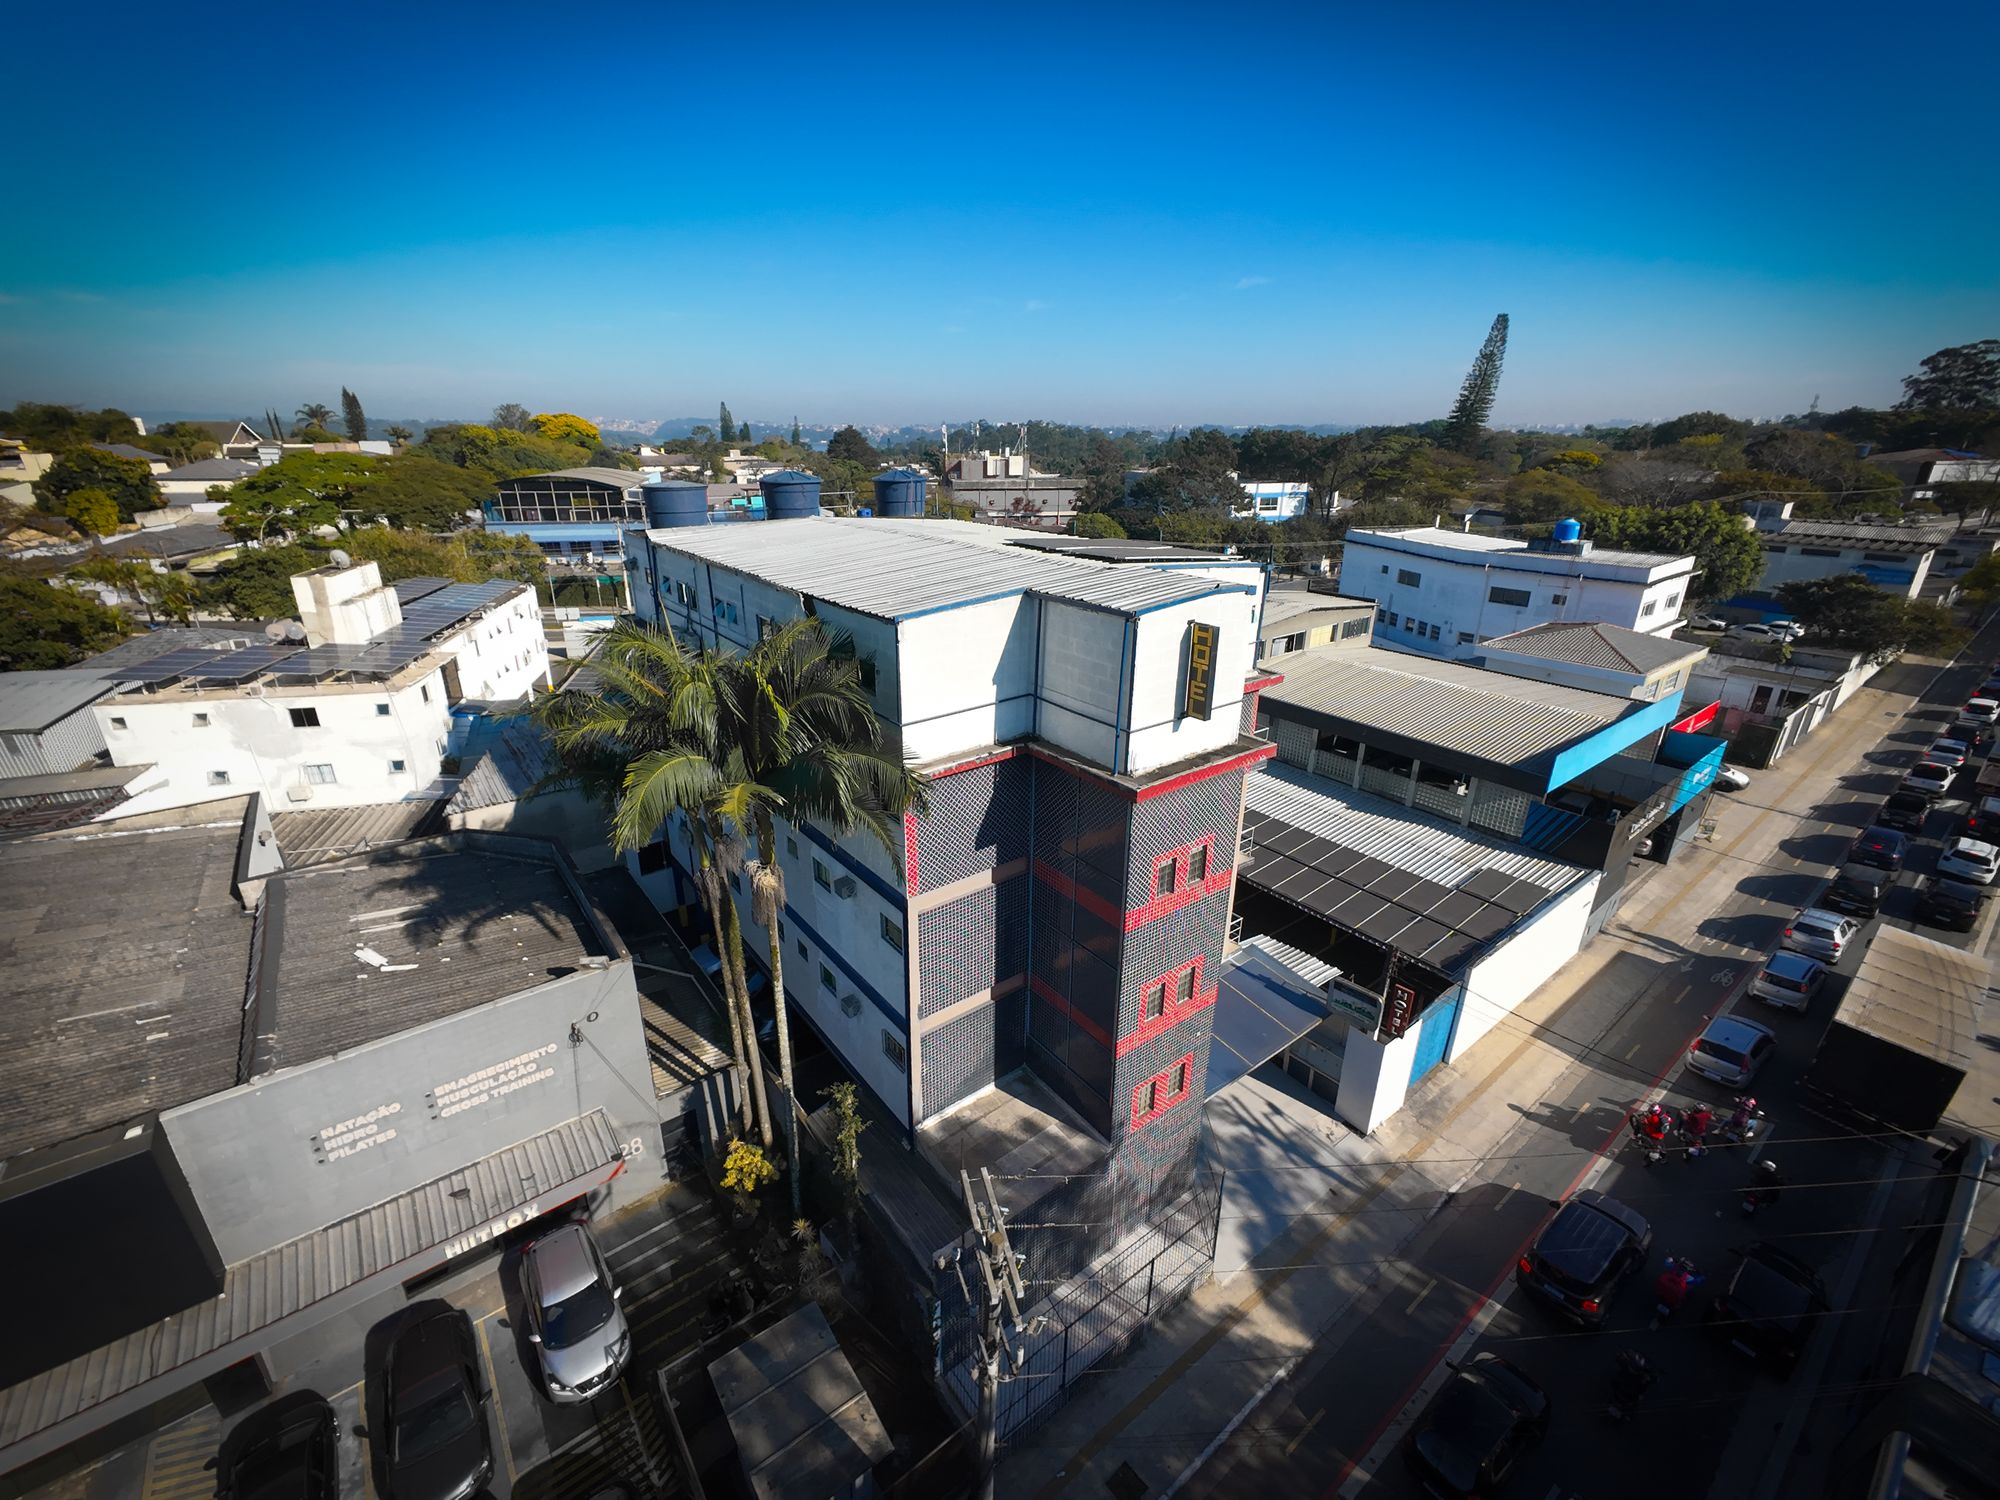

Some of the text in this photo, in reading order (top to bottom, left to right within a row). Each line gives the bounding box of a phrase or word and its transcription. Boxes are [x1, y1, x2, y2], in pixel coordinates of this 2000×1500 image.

[1188, 624, 1213, 719] HOTEL
[433, 1042, 558, 1097] EMAGRECIMENTO
[436, 1062, 537, 1107] MUSCULAÇÃO
[440, 1067, 554, 1118] CROSS TRAINING
[320, 1102, 401, 1139] NATAÇÃO
[323, 1123, 378, 1151] HIDRO
[327, 1128, 397, 1162] PILATES
